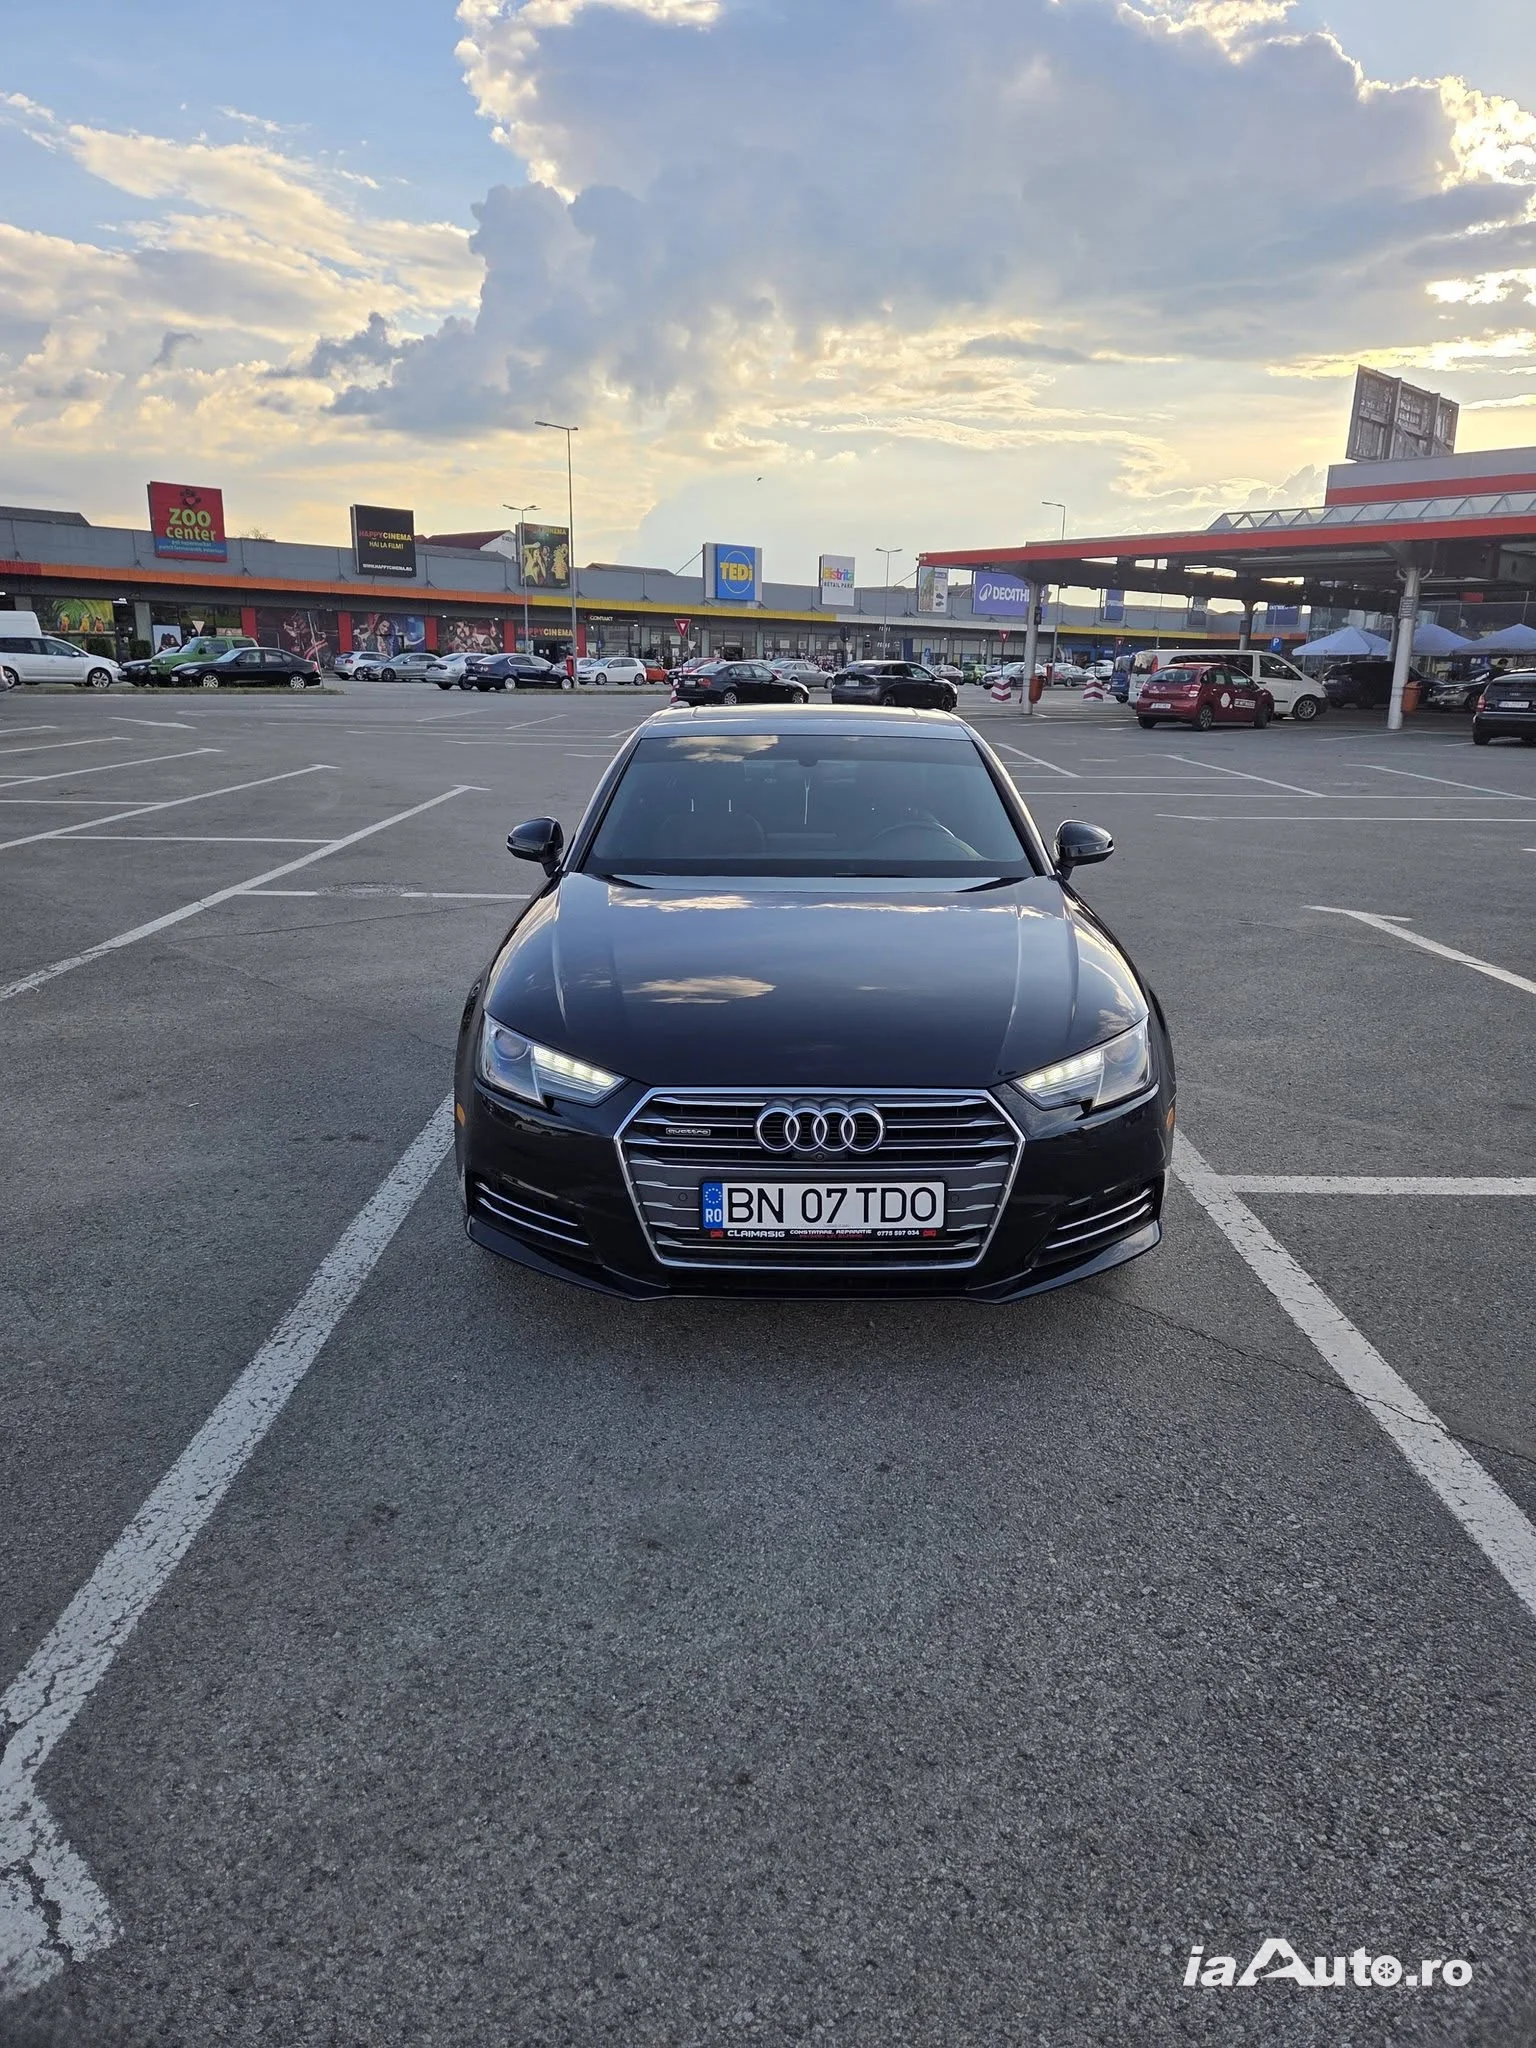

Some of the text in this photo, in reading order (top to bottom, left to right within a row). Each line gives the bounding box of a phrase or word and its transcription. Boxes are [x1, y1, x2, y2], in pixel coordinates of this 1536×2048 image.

[166, 526, 216, 541] center
[720, 562, 753, 581] TEDi
[1273, 638, 1280, 647] P
[667, 1128, 710, 1136] quattro
[727, 1186, 937, 1224] BN 07 TDO
[705, 1208, 722, 1223] RO
[727, 1230, 786, 1238] CLAIMASIG
